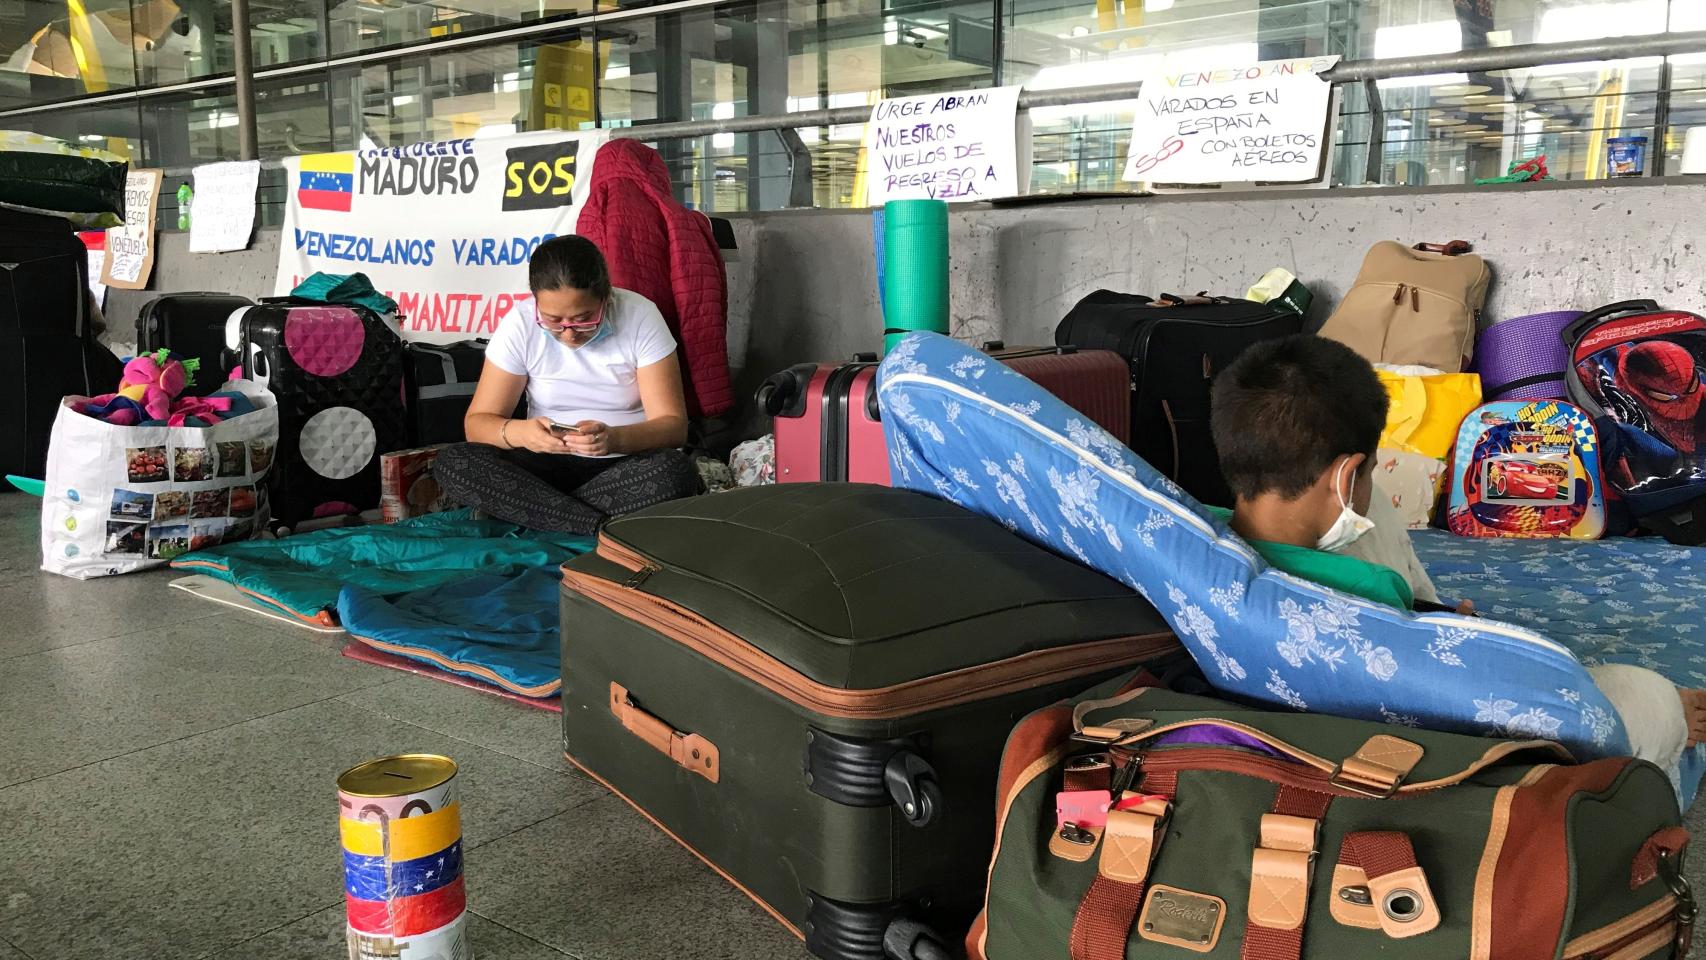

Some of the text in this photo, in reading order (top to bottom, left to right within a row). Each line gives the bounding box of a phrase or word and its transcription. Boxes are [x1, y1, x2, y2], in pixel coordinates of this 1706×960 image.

[876, 93, 989, 121] URGE ABRAN
[1148, 88, 1279, 116] VARADOS EN
[875, 123, 956, 149] NUESTROS
[1178, 112, 1271, 135] ESPAÑA
[882, 142, 985, 172] VUELOS DE
[1135, 136, 1184, 174] SOS
[1201, 134, 1316, 154] CON BOLETOS
[359, 156, 480, 196] MADURO
[505, 156, 576, 198] SOS
[884, 165, 997, 192] REGRESO A
[111, 236, 147, 255] VENEZUELA
[294, 227, 558, 267] VENEZOLANOS VARADO
[1518, 402, 1537, 421] HOT
